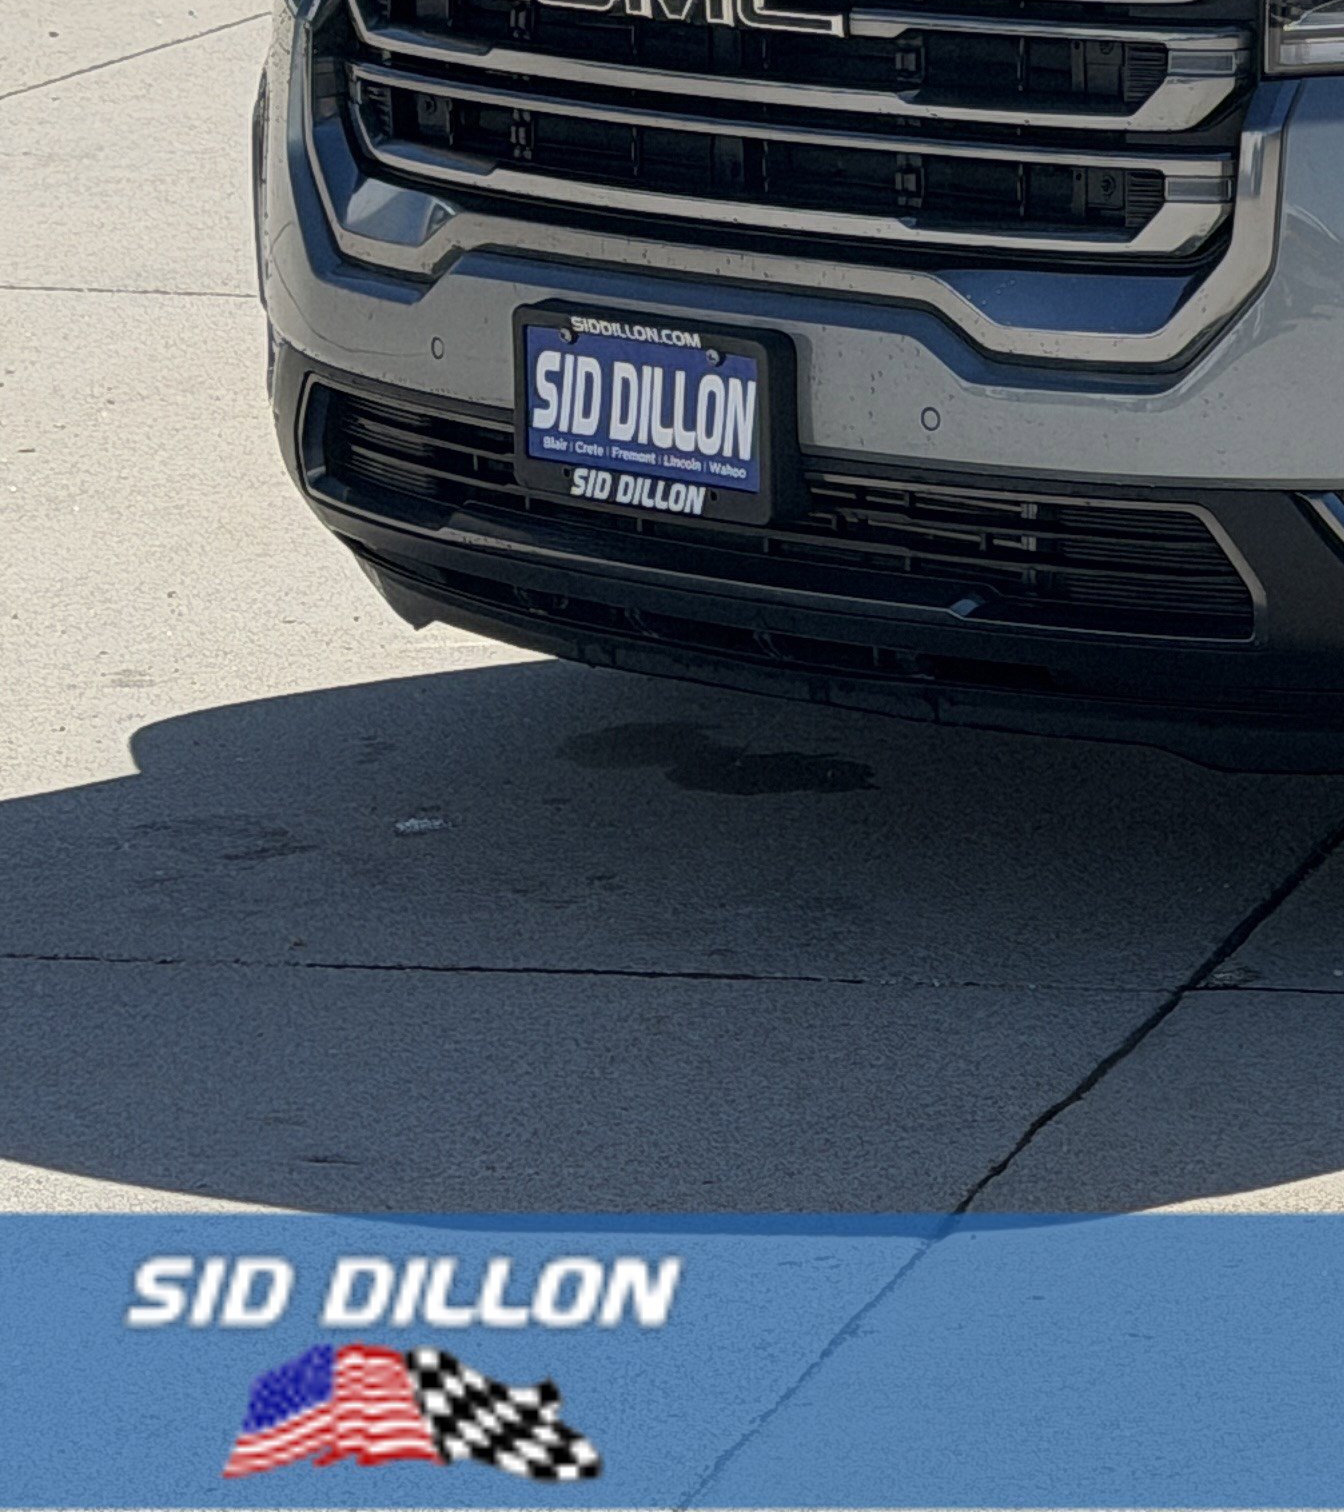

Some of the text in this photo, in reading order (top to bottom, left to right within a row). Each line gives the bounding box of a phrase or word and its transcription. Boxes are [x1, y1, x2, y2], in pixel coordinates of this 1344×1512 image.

[571, 317, 701, 348] SIDDILLON.COM
[533, 351, 756, 460] SID DILLON
[570, 468, 706, 515] SID DILLON
